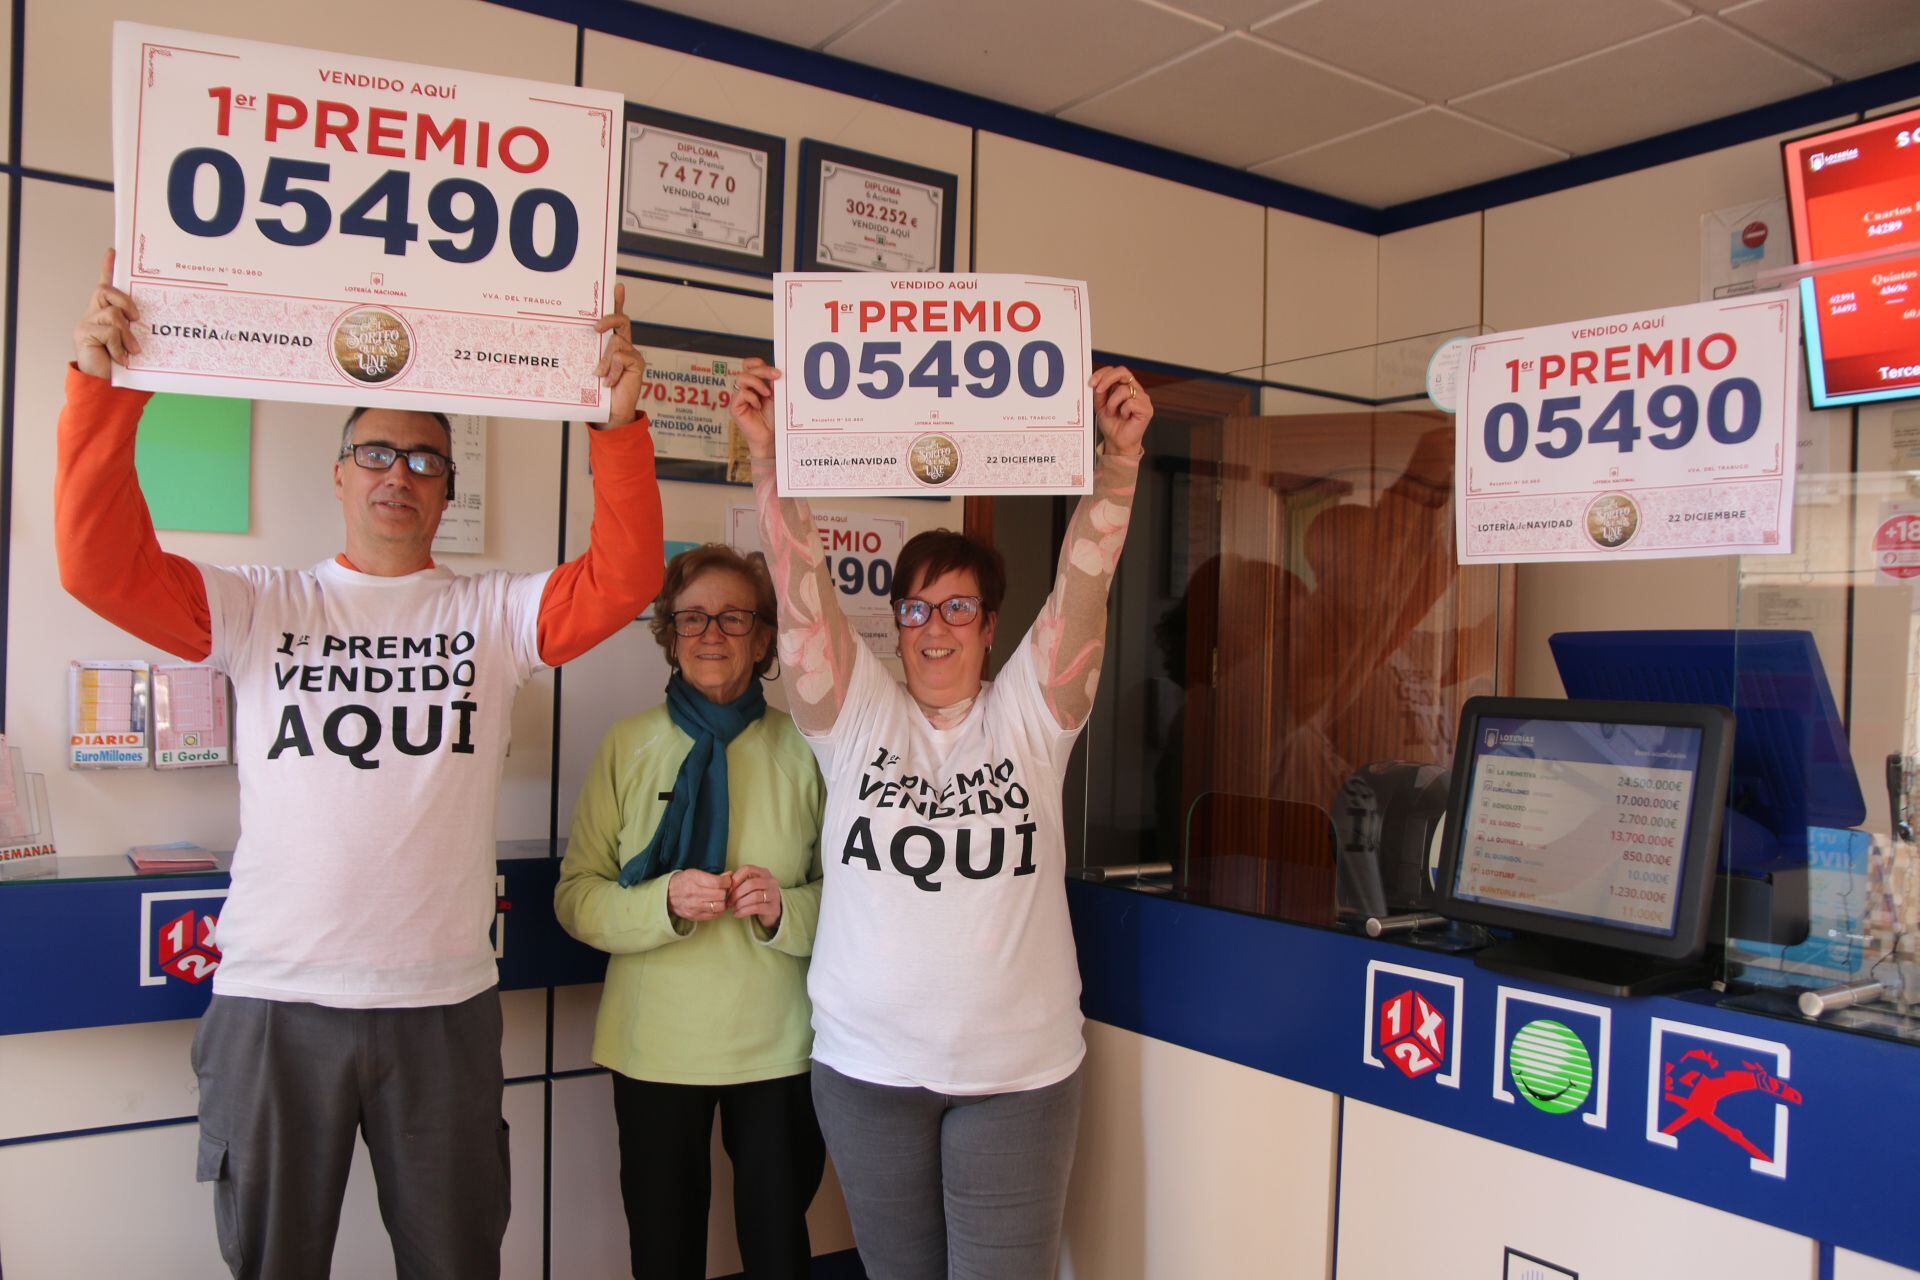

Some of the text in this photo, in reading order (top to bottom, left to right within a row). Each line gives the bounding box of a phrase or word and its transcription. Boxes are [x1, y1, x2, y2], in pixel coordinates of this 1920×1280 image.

[318, 68, 457, 100] VENDIDO AQUÍ
[264, 92, 550, 174] PREMIO
[677, 142, 720, 159] DIPLOMA
[658, 160, 736, 193] 74770
[662, 184, 730, 207] VENDIDO AQUÍ
[864, 180, 902, 196] DIPLOMA
[166, 146, 579, 273] 05490
[845, 198, 908, 225] 302.252
[852, 218, 911, 239] VENDIDO AQUÍ
[890, 278, 978, 291] VENDIDO AQUÍ
[505, 293, 521, 302] DEL
[523, 295, 563, 306] TRABUCO
[859, 300, 1041, 333] PREMIO
[151, 324, 219, 341] LOTERÍA
[238, 330, 313, 347] NAVIDAD
[1571, 315, 1665, 340] VENDIDO AQUÍ
[454, 349, 560, 369] 22 DICIEMBRE
[1538, 332, 1738, 391] PREMIO
[646, 368, 726, 388] ENHORABUENA
[803, 339, 1065, 401] 05490
[649, 418, 695, 432] VENDIDO
[697, 422, 722, 436] AQUÍ
[1483, 376, 1762, 464] 05490
[851, 456, 897, 466] NAVIDAD
[986, 455, 1056, 464] 22 DICIEMBRE
[1526, 519, 1574, 530] NAVIDAD
[1668, 510, 1747, 523] 22 DICIEMBRE
[817, 528, 882, 554] EMIO
[322, 630, 475, 660] PREMIO
[274, 659, 476, 693] VENDIDO
[70, 734, 139, 746] DIARIO
[267, 692, 478, 770] AQUÍ
[75, 749, 143, 763] EuroMillones
[162, 749, 219, 762] El Gordo
[1617, 776, 1683, 792] 24.500.000€
[858, 773, 1030, 821] VENDIDO
[1616, 794, 1680, 810] 17.000.000€
[1618, 812, 1678, 829] 2.700.000€
[1610, 830, 1675, 848] 13.700.000€
[841, 813, 1037, 892] AQUÍ
[1622, 850, 1673, 866] 850.000€
[1628, 870, 1670, 885] 10.000€
[1610, 885, 1667, 904] 1.230.000€
